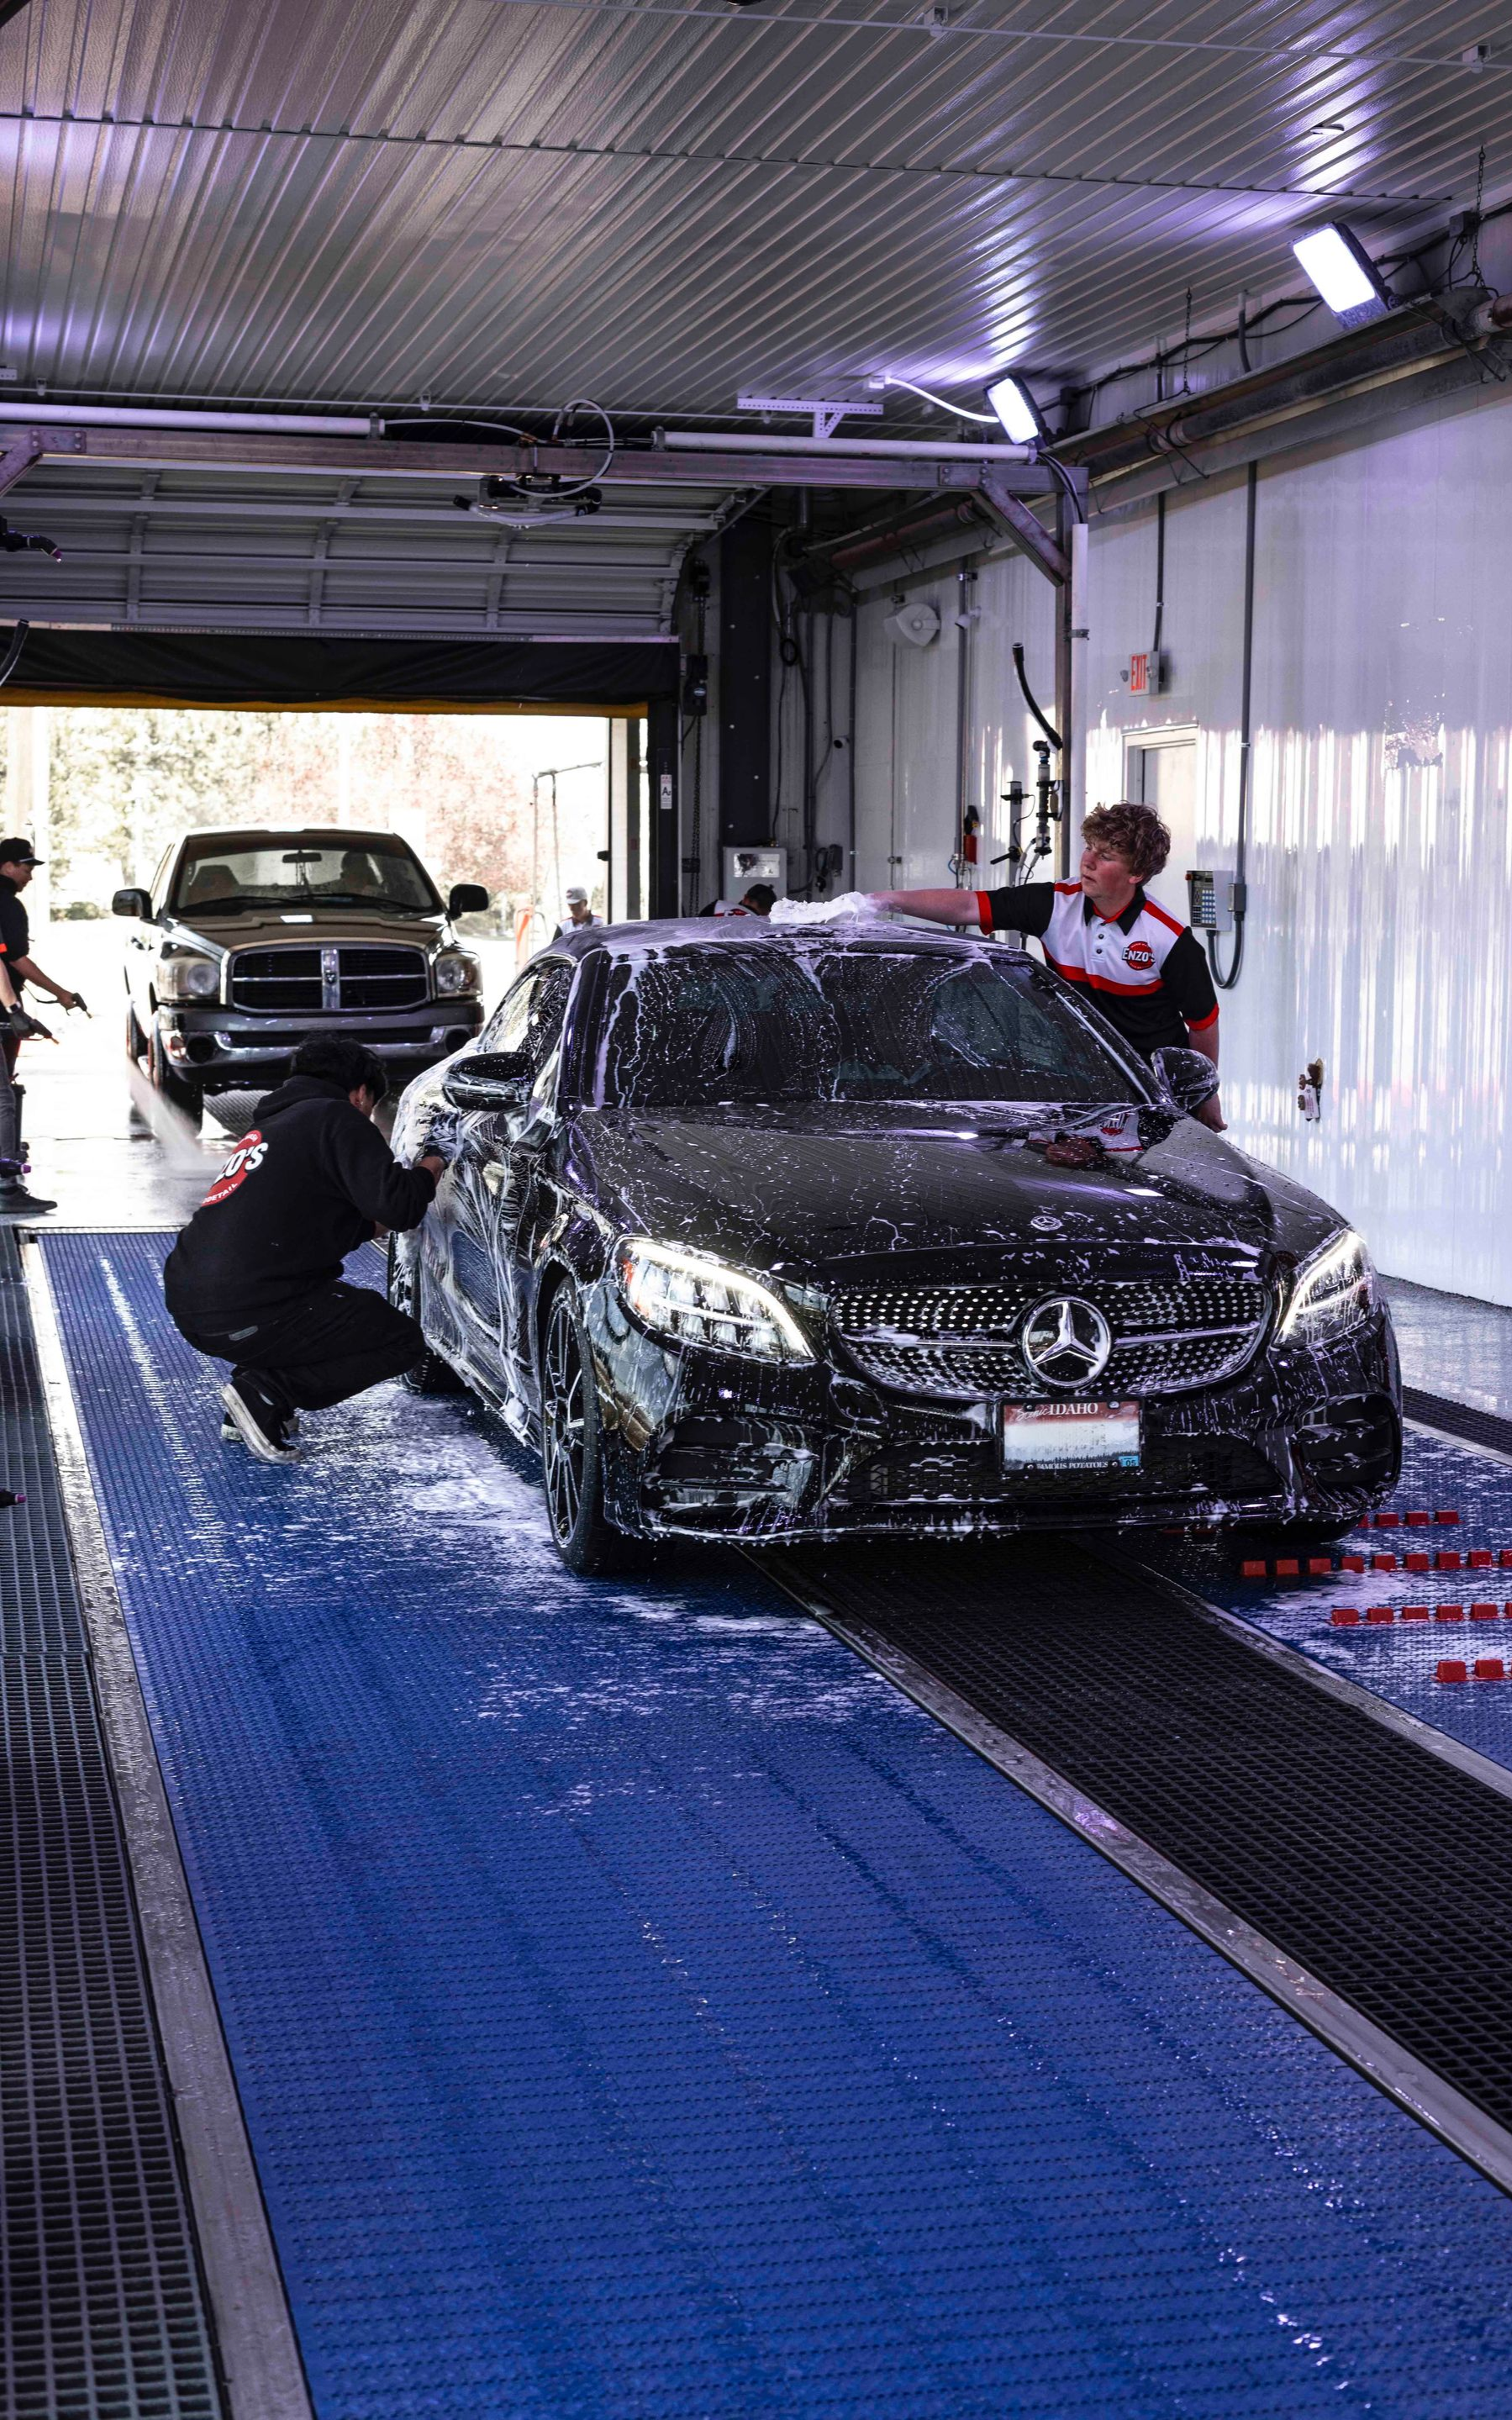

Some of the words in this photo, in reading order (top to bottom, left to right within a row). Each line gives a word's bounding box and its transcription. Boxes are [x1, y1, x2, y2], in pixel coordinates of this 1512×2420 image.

[1131, 654, 1147, 691] EXIT
[1122, 947, 1156, 962] ENZO'S
[1015, 1407, 1051, 1421] Scenic
[1051, 1403, 1098, 1415] IDAHO
